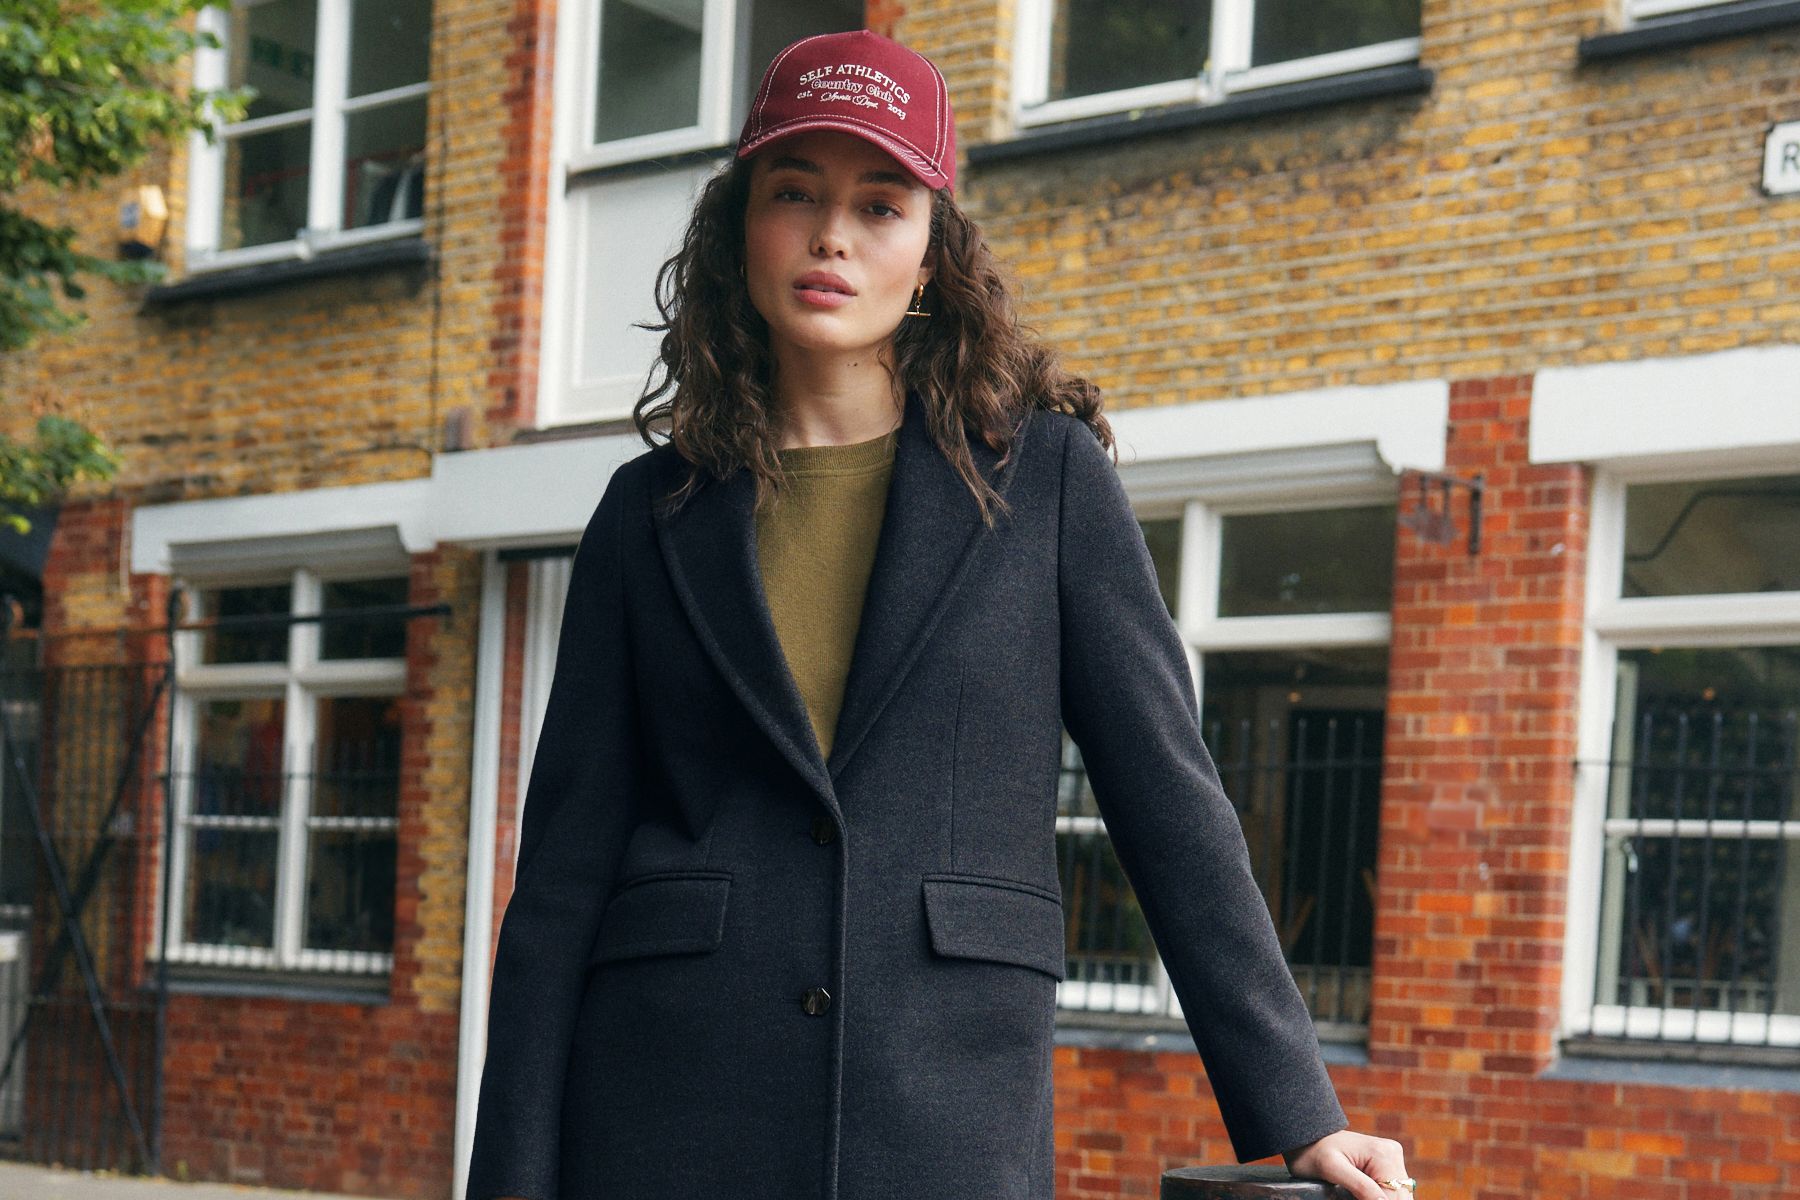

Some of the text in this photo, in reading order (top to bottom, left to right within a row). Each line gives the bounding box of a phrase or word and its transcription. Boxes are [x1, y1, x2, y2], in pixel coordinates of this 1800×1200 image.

[799, 64, 911, 105] SELF ATHLETICS
[811, 79, 895, 104] Country Club
